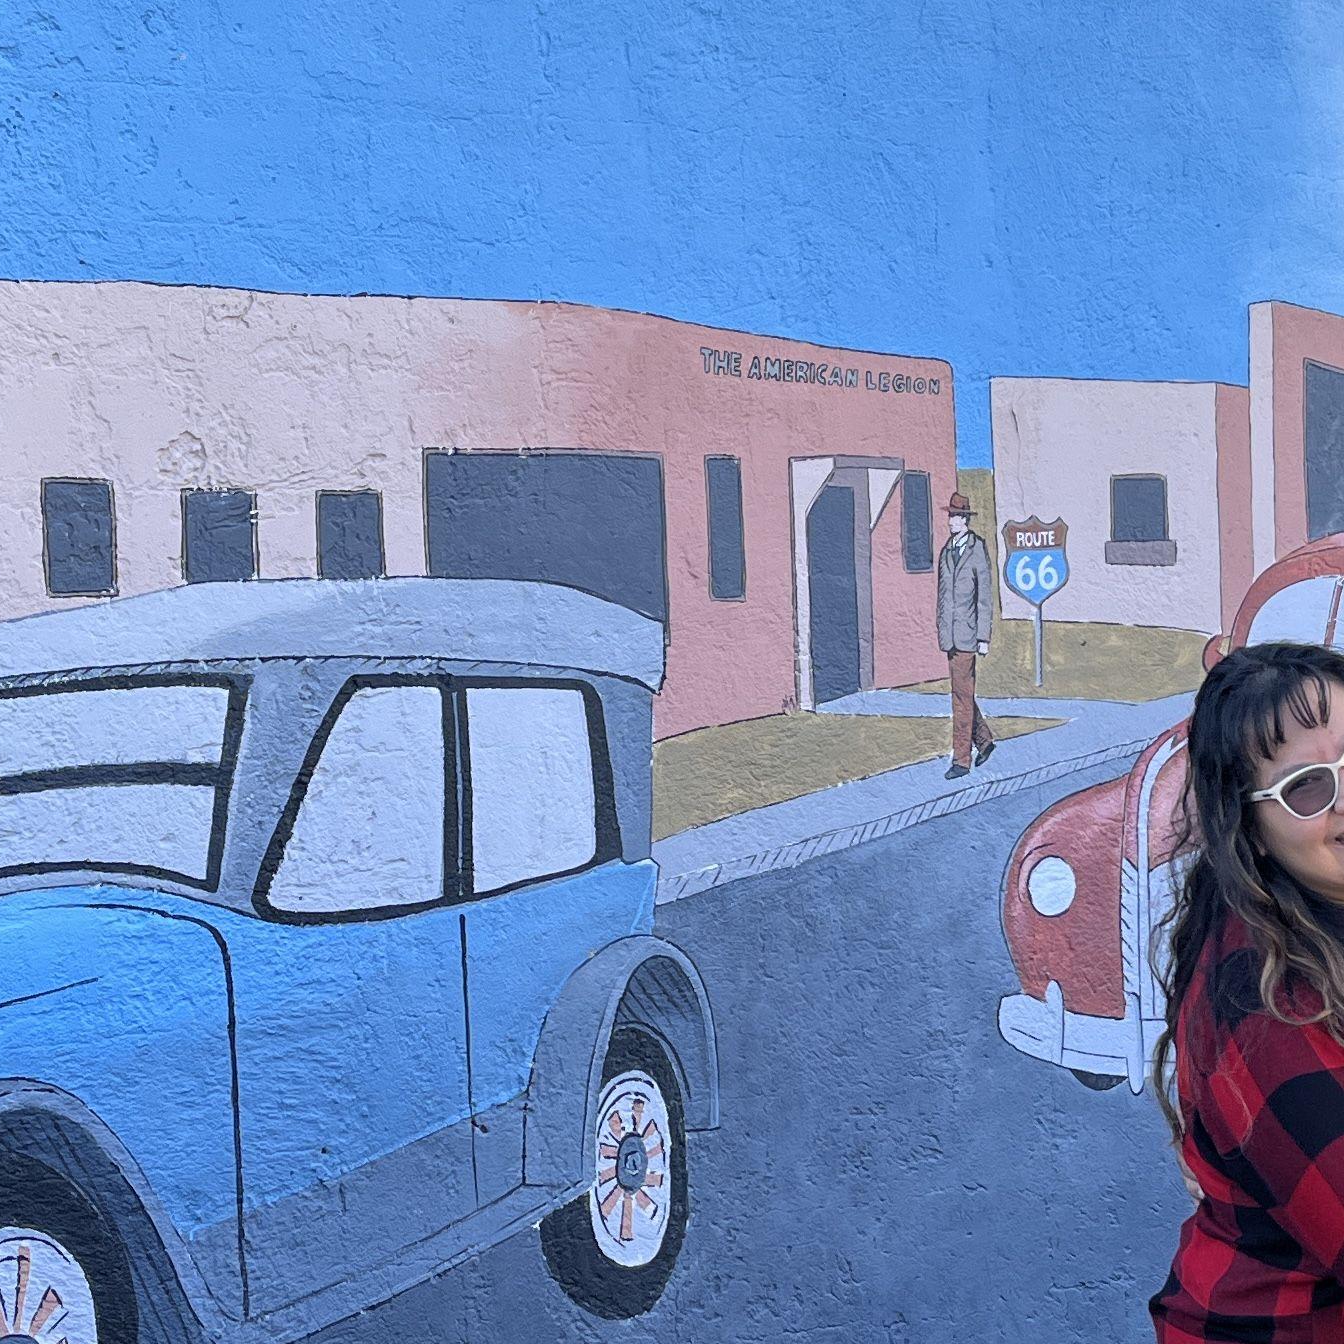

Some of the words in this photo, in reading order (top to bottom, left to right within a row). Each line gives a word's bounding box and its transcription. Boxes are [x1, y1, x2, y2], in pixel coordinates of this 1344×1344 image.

[699, 346, 742, 378] THE
[747, 356, 858, 388] AMERICAN
[865, 370, 941, 395] LEGION
[1015, 529, 1056, 549] ROUTE
[1015, 554, 1058, 592] 66
